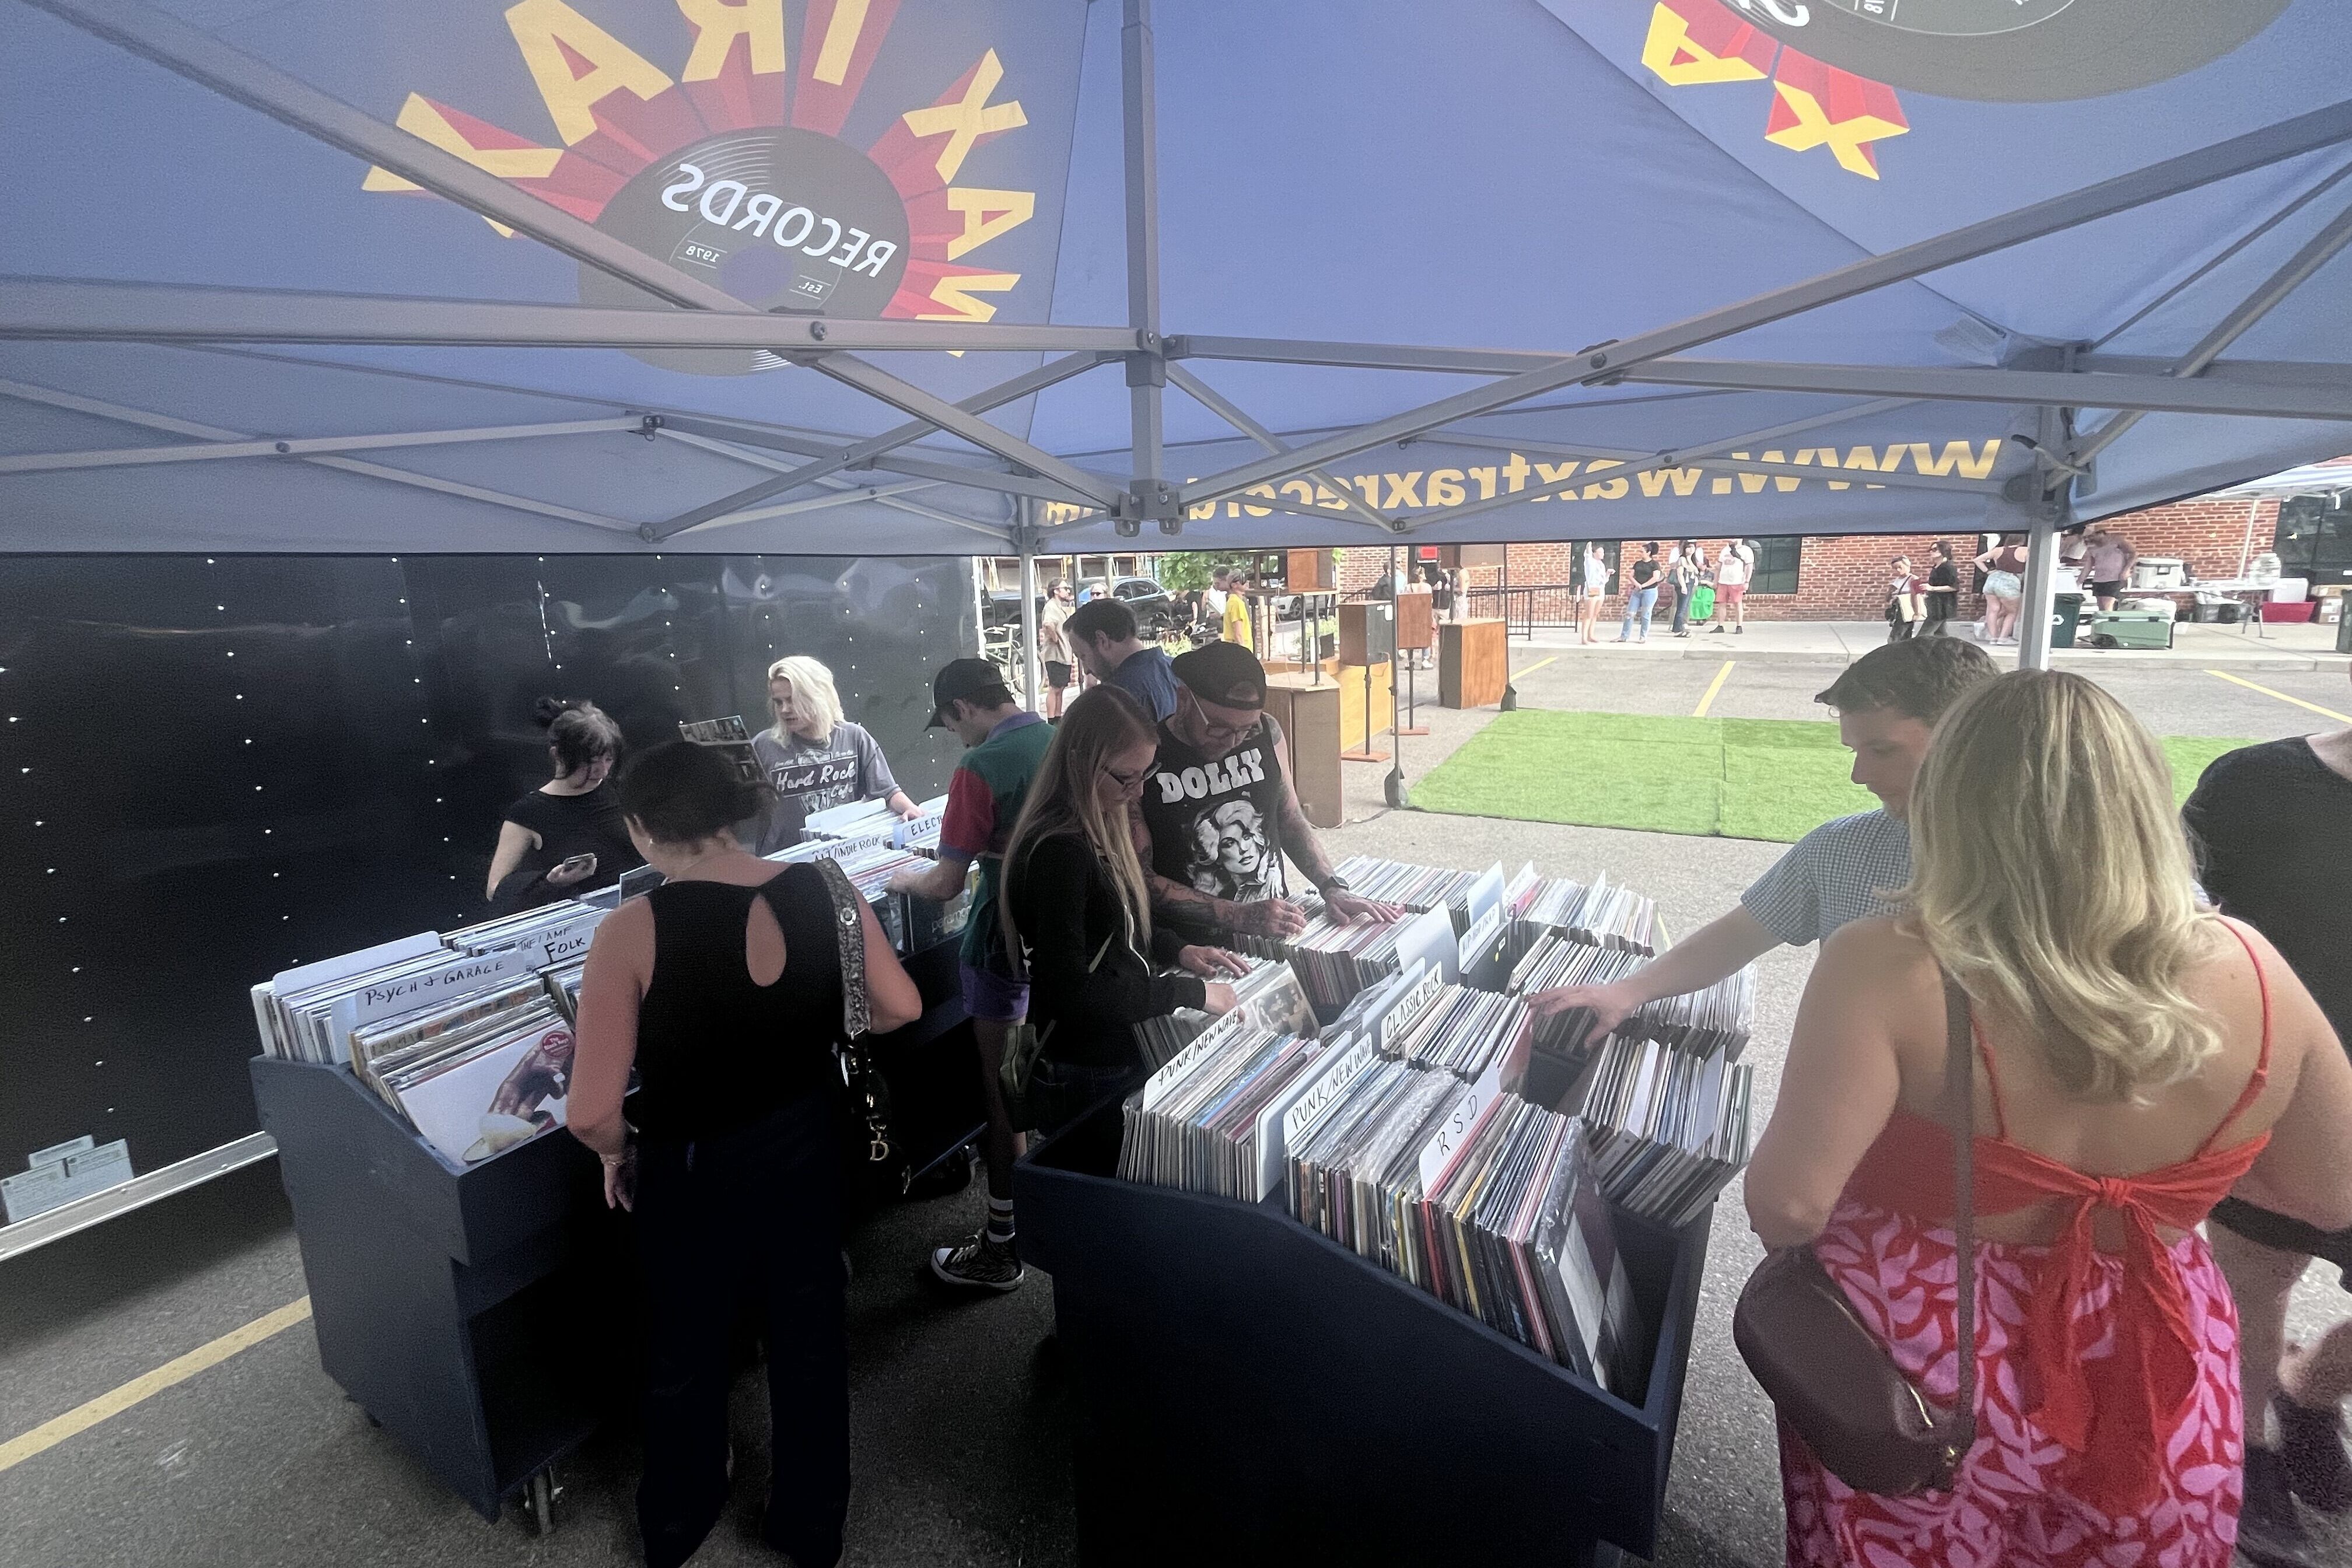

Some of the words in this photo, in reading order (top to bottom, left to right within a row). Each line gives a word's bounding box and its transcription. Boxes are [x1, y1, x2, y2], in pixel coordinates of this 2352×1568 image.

[776, 770, 815, 792] Hard
[820, 761, 856, 784] Rock
[1156, 747, 1265, 804] DOLLY
[544, 937, 586, 963] FOLK
[365, 981, 418, 1006] PSYCH
[444, 961, 505, 985] GARAGE
[1387, 990, 1421, 1039] CLASSIC
[1422, 968, 1439, 1003] ROCK
[1292, 1054, 1353, 1130] PUNK/NEW
